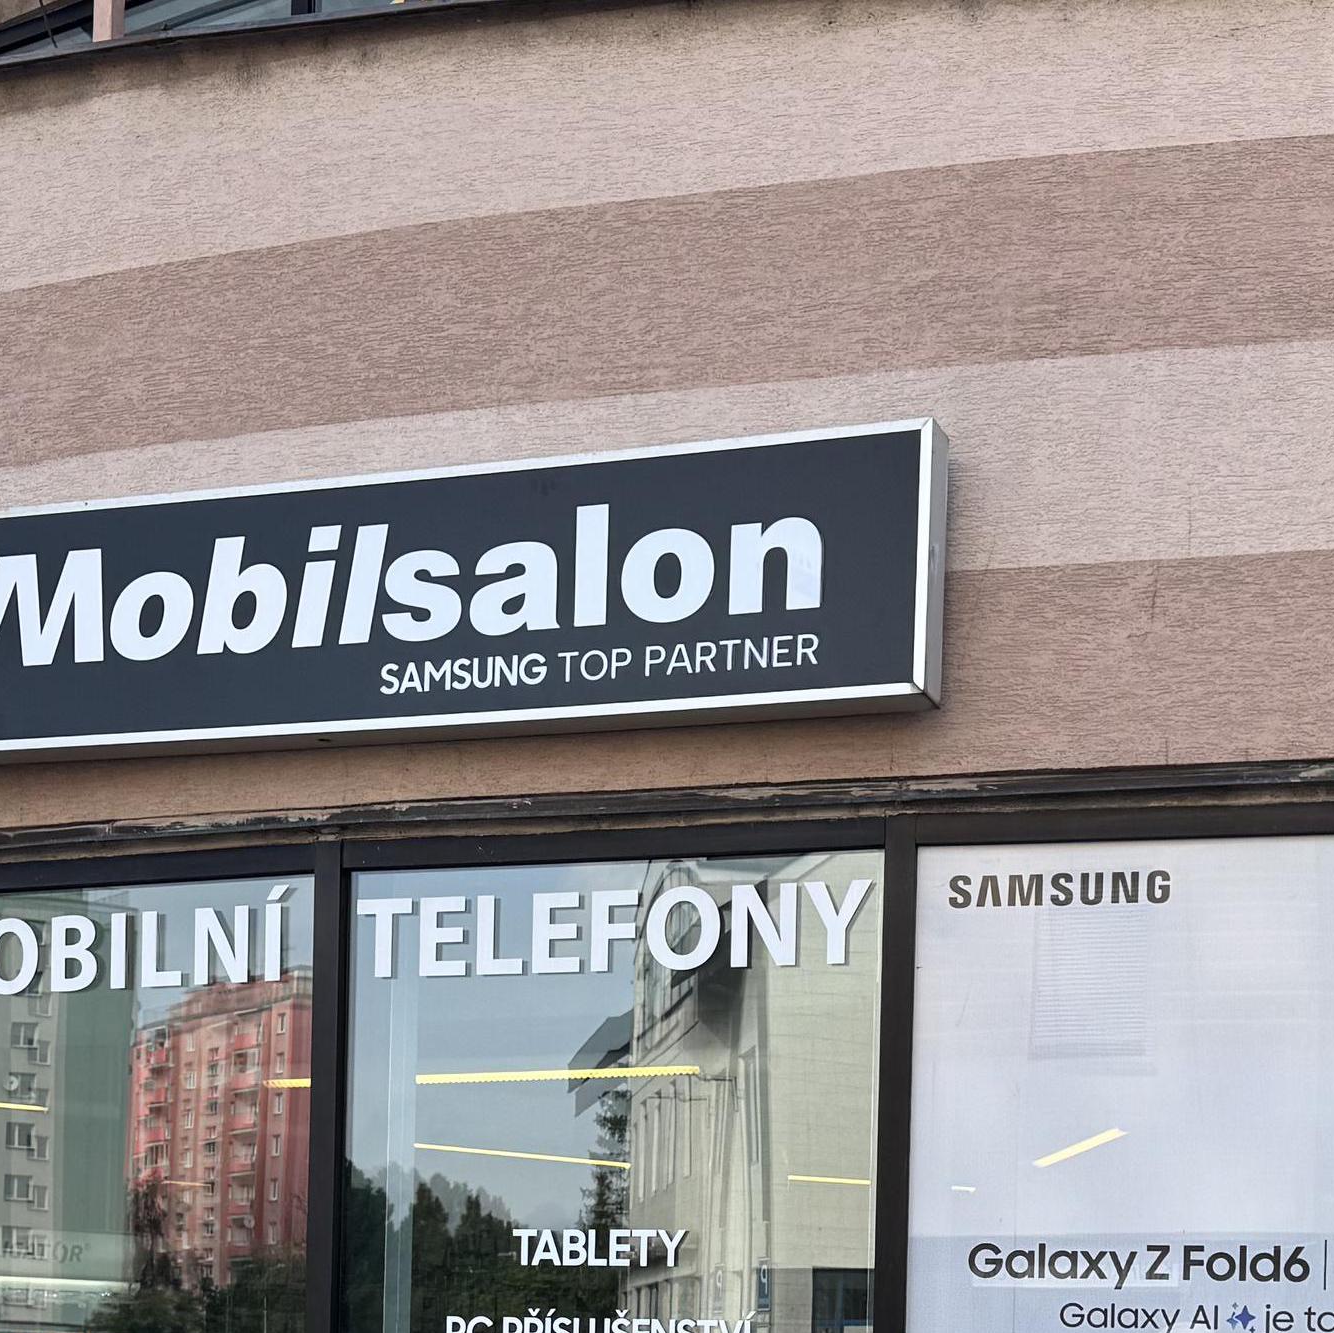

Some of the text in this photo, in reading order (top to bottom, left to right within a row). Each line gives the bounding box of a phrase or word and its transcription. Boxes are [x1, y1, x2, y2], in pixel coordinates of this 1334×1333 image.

[379, 633, 818, 697] SAMSUNG TOP PARTNER
[948, 870, 1171, 908] SAMSUNG
[357, 878, 874, 978] TELEFONY
[512, 1227, 686, 1268] TABLETY
[968, 1243, 1138, 1290] Galaxy
[1146, 1245, 1170, 1281] Z
[1183, 1245, 1310, 1284] Fold6
[1190, 1306, 1219, 1331] AI
